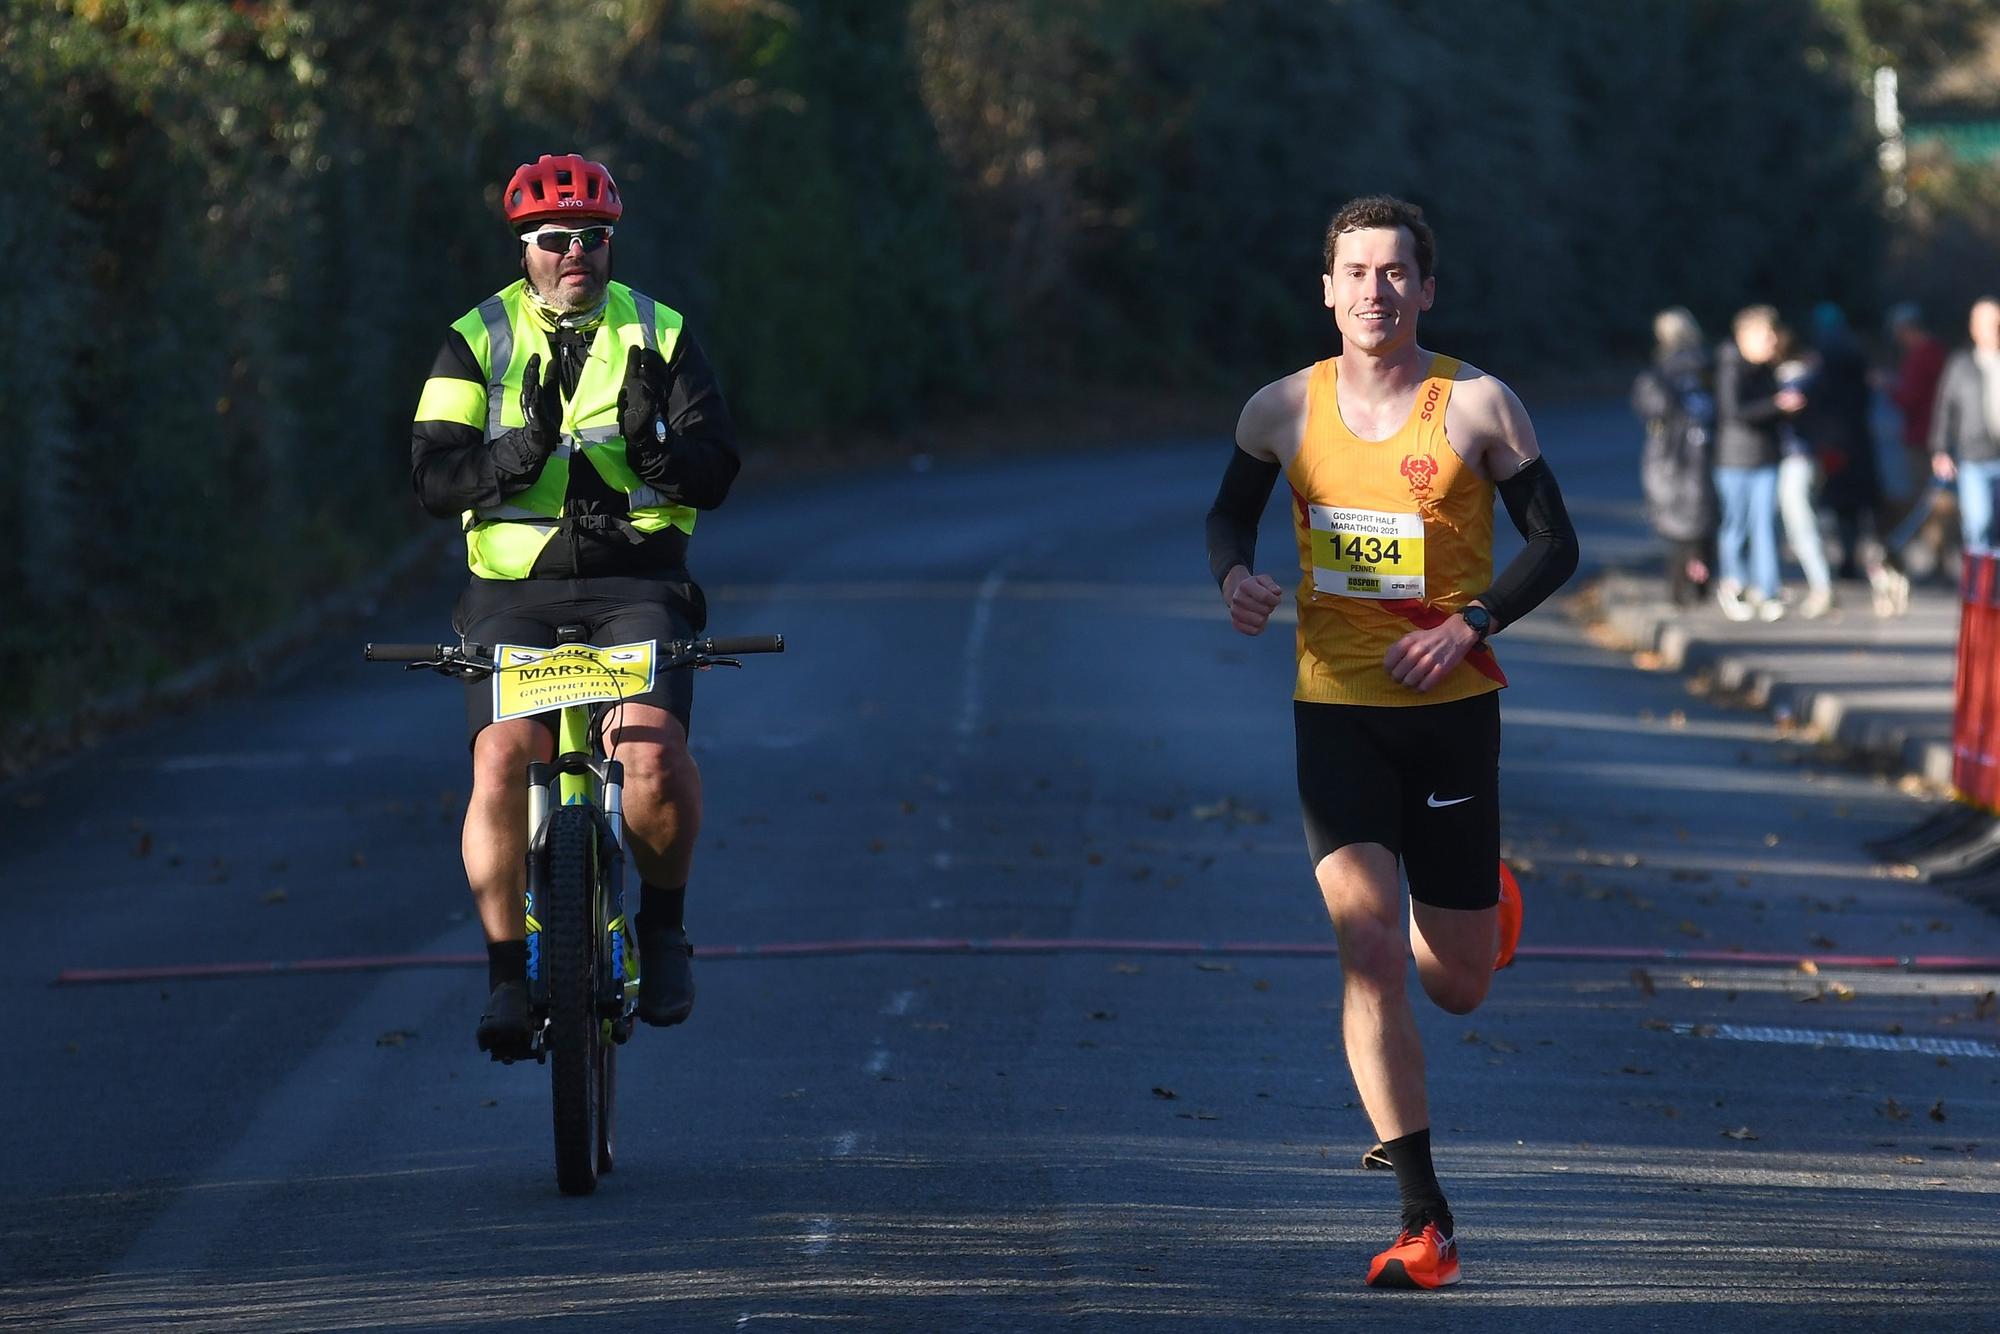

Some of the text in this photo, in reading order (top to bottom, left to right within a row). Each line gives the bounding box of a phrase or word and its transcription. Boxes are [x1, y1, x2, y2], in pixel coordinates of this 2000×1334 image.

[557, 200, 584, 208] 3170
[1420, 382, 1442, 422] soar
[1333, 511, 1397, 525] GOSPORT HALF
[1330, 521, 1399, 535] MARATHON 2021
[1329, 534, 1402, 565] 1434
[1350, 564, 1376, 573] PENNEY
[519, 664, 631, 681] MARSHAL
[520, 681, 588, 698] GOSPORT
[534, 690, 613, 706] MARATHON
